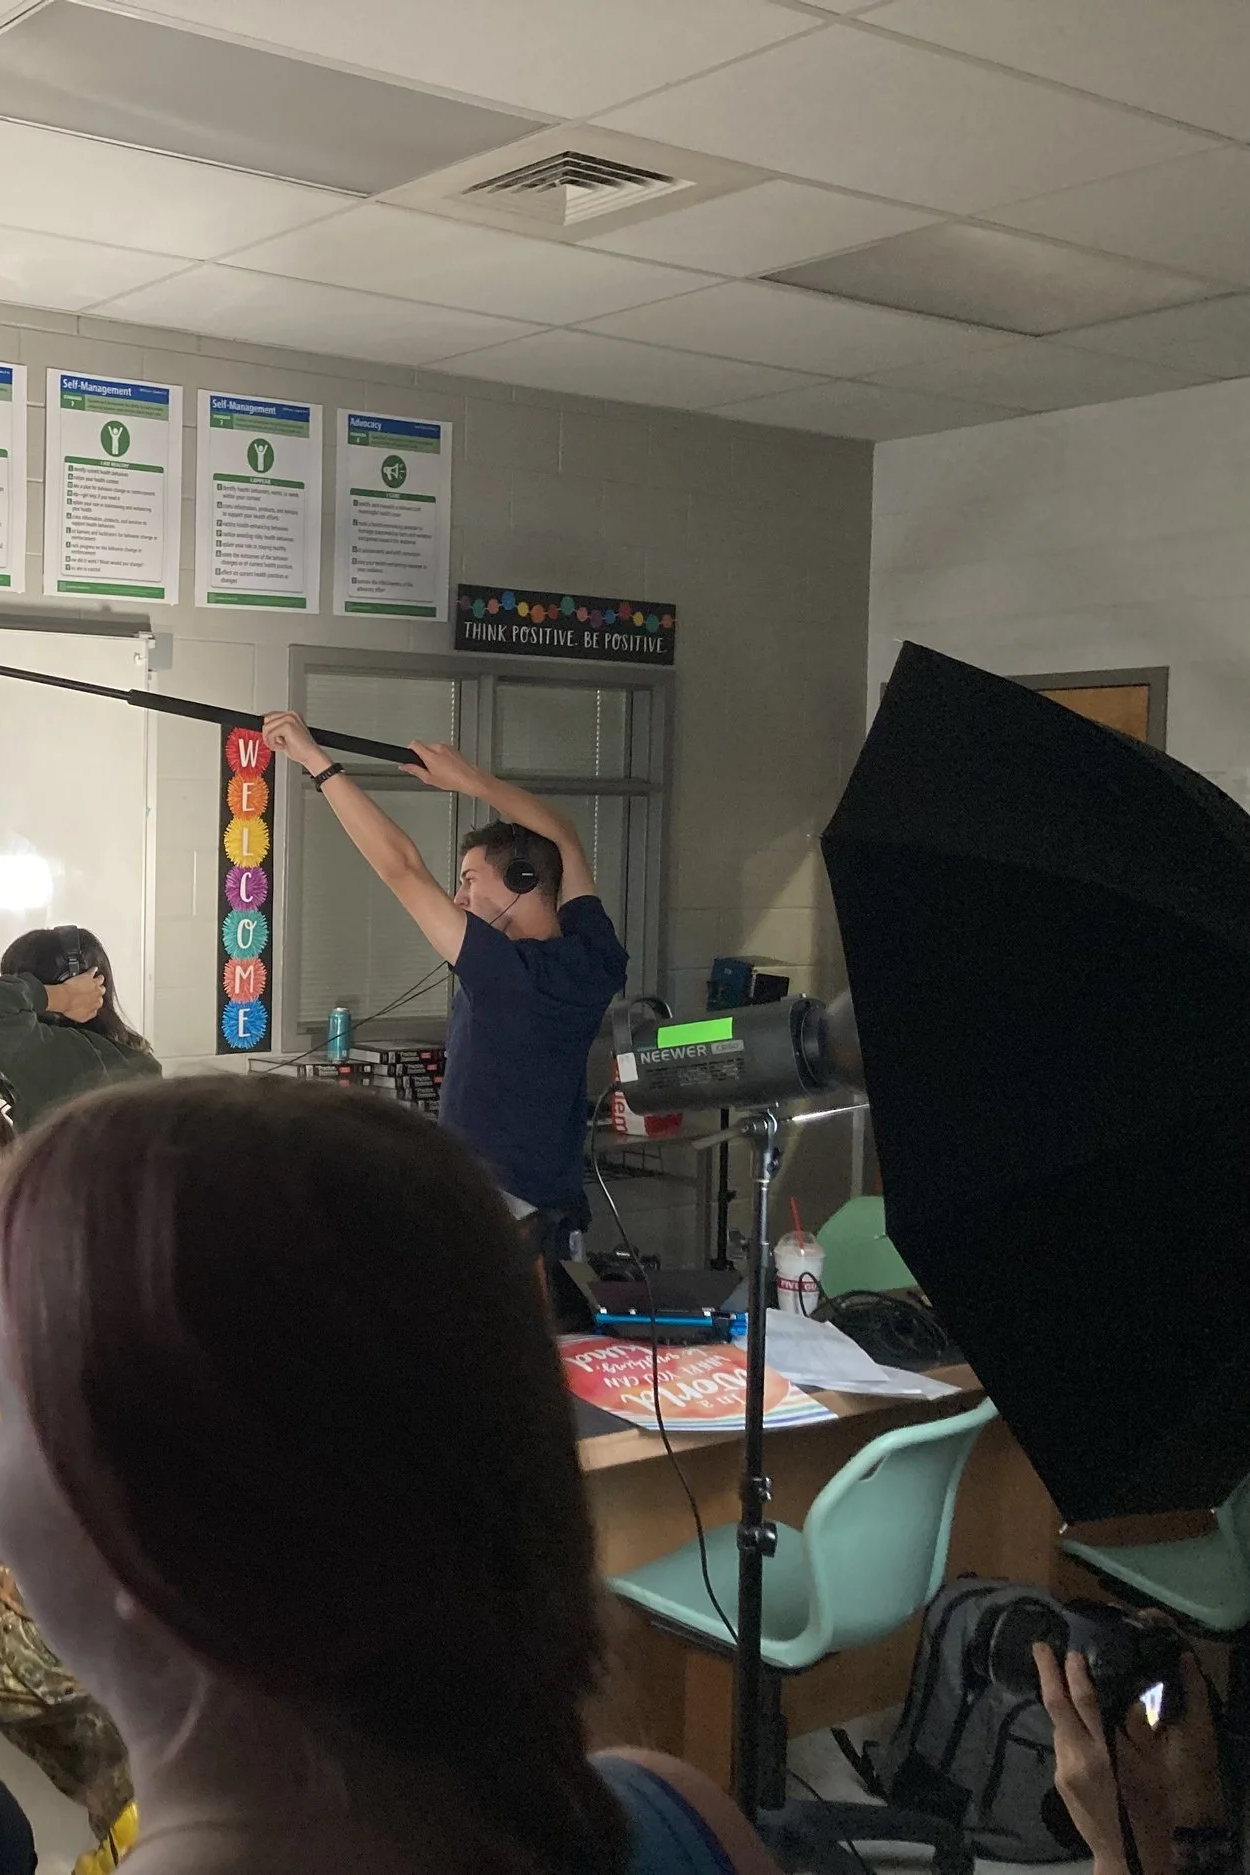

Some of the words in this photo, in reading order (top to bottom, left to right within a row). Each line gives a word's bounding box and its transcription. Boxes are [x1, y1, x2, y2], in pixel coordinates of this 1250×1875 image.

[63, 378, 132, 397] Self-Management
[212, 398, 277, 415] Self-Management
[350, 417, 383, 431] Advocacy
[464, 621, 507, 643] THINK
[512, 625, 579, 647] POSITIVE.
[584, 631, 600, 649] BE
[604, 633, 667, 654] POSITIVE.
[640, 1044, 707, 1065] NEEWER
[804, 1283, 817, 1291] GU
[602, 1374, 640, 1389] CAN
